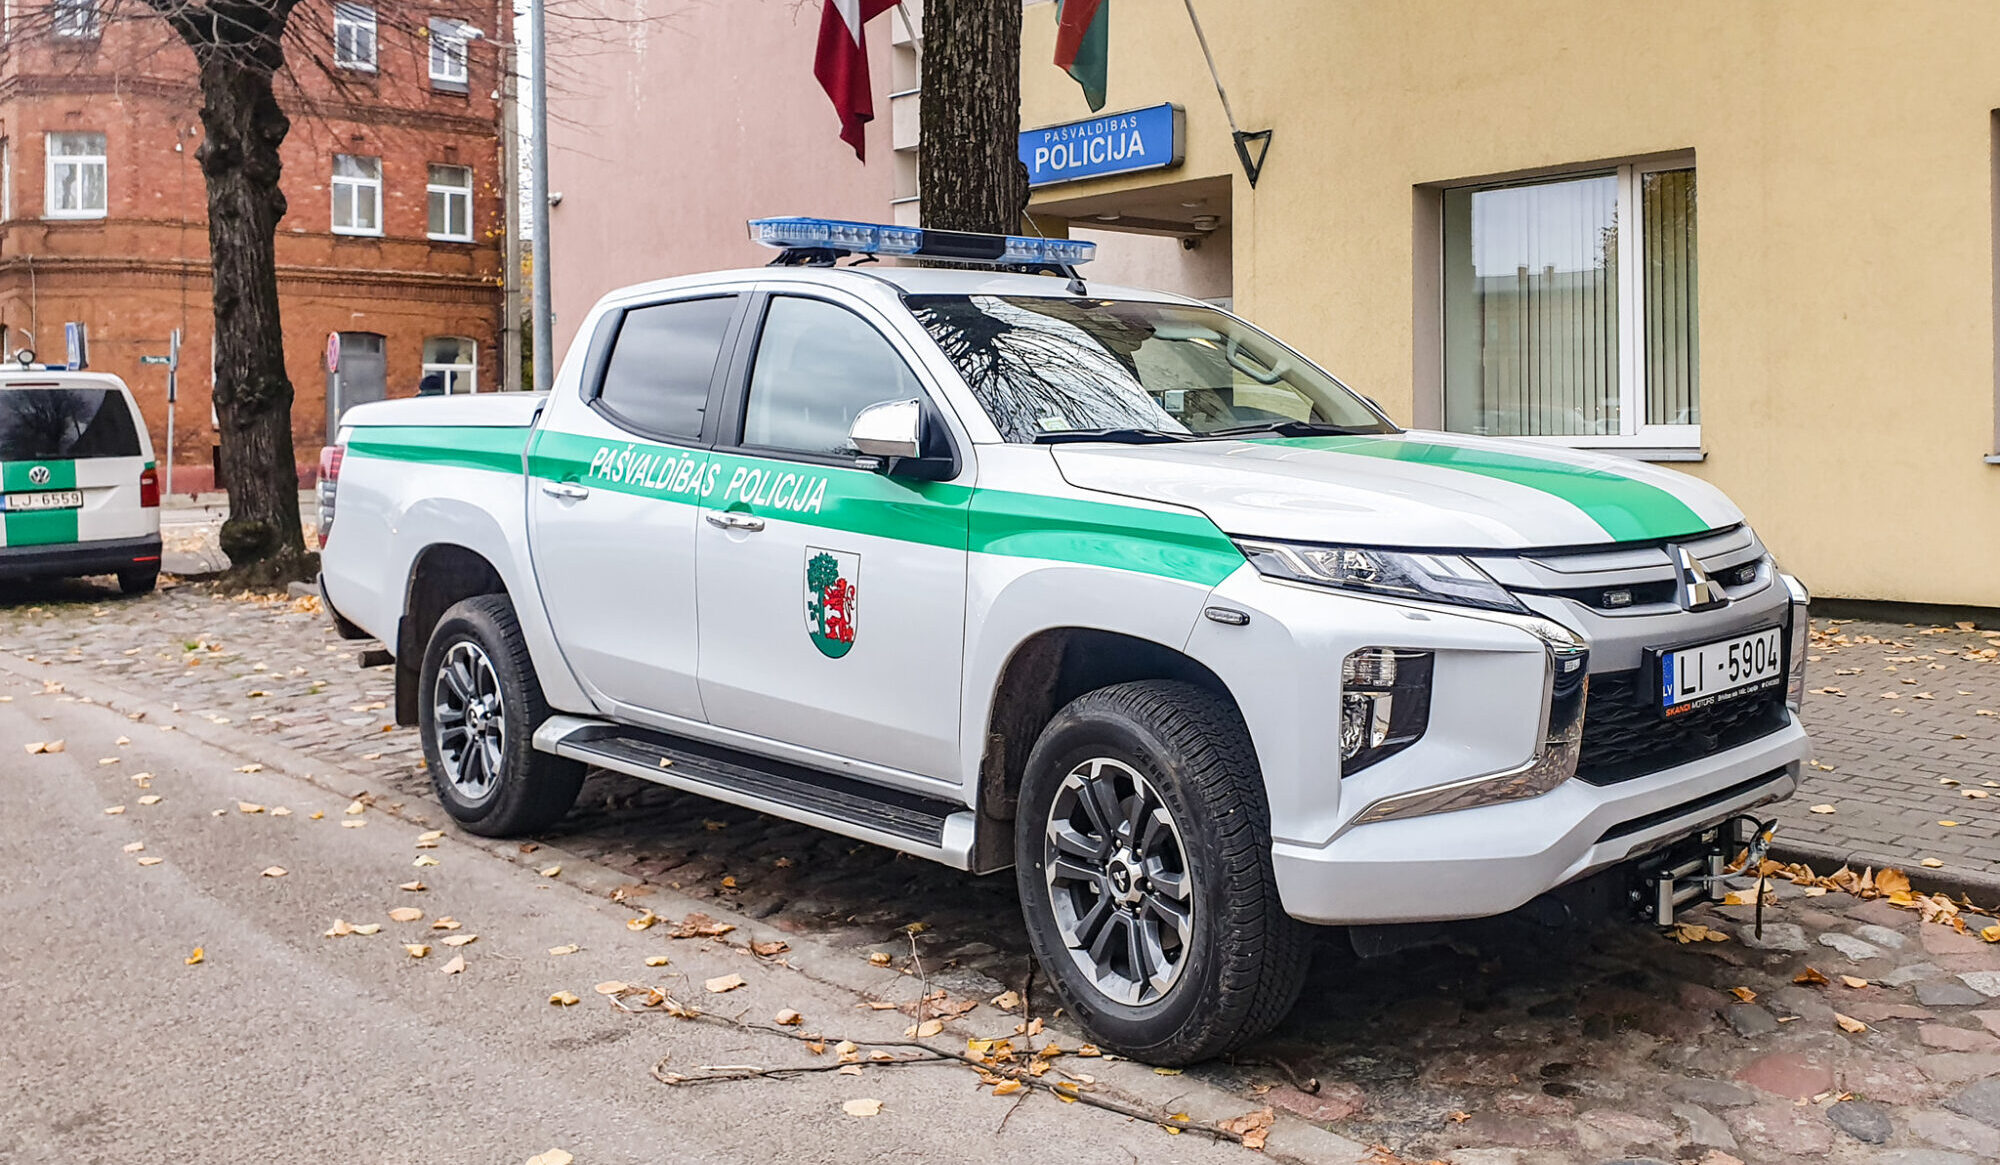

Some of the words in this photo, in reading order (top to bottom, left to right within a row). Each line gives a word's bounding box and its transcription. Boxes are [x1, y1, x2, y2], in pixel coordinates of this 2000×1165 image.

[1044, 116, 1137, 143] PAŠVALDĪBAS
[1035, 130, 1145, 173] POLICIJA
[589, 443, 721, 498] PAŠVALDĪBAS
[724, 467, 828, 514] POLICIJA
[1663, 684, 1673, 697] LV
[1691, 696, 1715, 709] MOTORS
